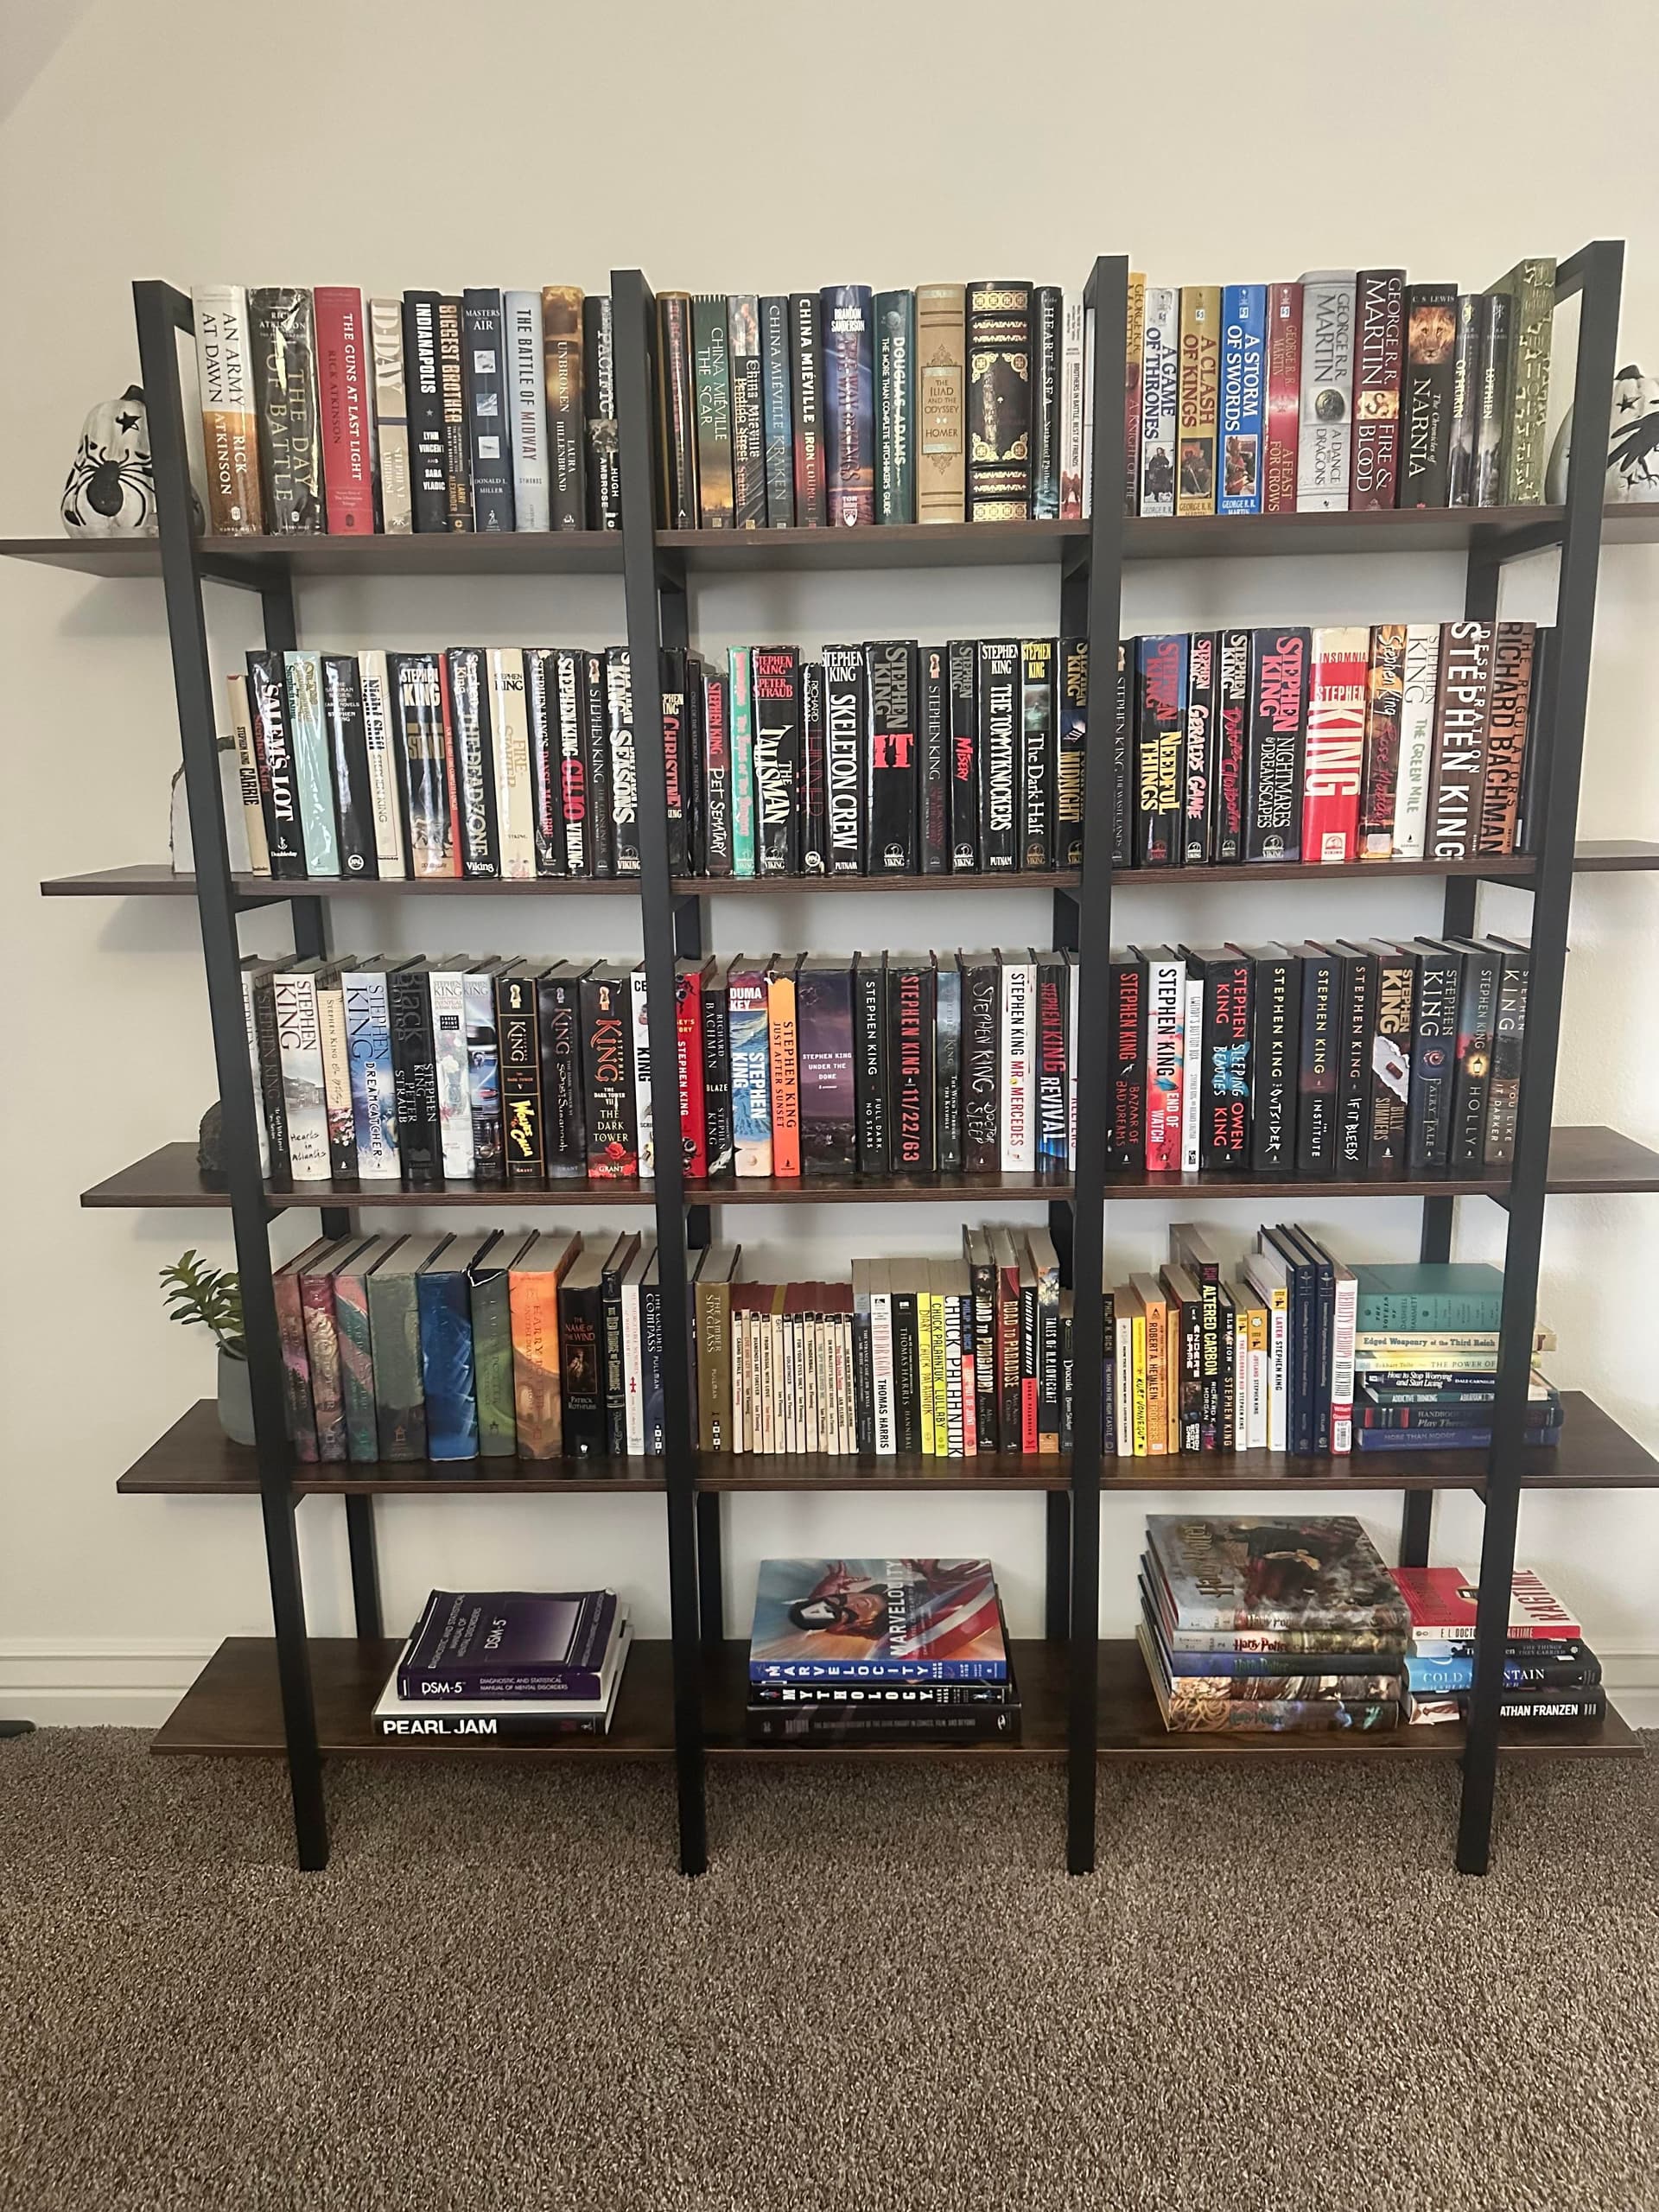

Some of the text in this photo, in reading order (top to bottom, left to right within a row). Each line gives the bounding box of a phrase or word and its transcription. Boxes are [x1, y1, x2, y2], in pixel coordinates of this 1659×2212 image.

[202, 313, 223, 403] AT DAWN
[416, 302, 435, 394] INDIANAPOLIS
[439, 304, 460, 359] BIGGEST
[474, 320, 494, 331] AIR
[1314, 294, 1336, 382] MARTIN
[1362, 278, 1387, 385] MARTIN
[1384, 277, 1402, 385] GEORGE R. R.
[223, 313, 245, 406] AN ARMY
[517, 309, 537, 461] THE BATTLE OF MIDWAY
[556, 341, 570, 413] UNBROKEN
[697, 347, 713, 427] THE SCAR
[711, 327, 728, 442] CHINA MIÉVILLE
[769, 304, 784, 429] CHINA MIÉVILLE
[799, 298, 817, 461] CHINA MIÉVILLE IRON
[1144, 327, 1161, 440] OF THRONES
[1160, 346, 1177, 417] A GAME
[1181, 334, 1198, 429] OF KINGS
[1199, 335, 1217, 426] A CLASH
[1224, 325, 1243, 432] OF SWORDS
[1243, 334, 1261, 417] A STORM
[343, 313, 362, 481] THE GUNS AT LAST LIGHT
[442, 364, 462, 423] BROTHER
[925, 405, 959, 414] ODYSSEY
[214, 413, 232, 495] ATKINSON
[233, 435, 247, 474] RICK
[270, 404, 293, 501] BATTLE
[289, 369, 314, 487] THE DAY
[556, 421, 566, 492] HILLENBRAND
[925, 429, 958, 438] HOMER
[1282, 449, 1294, 461] A
[1314, 429, 1327, 486] DRAGONS
[1356, 424, 1376, 492] BLOOD
[1378, 424, 1395, 463] FIRE
[1409, 378, 1433, 478] NARNIA
[600, 457, 609, 508] AMBROSE
[1268, 467, 1281, 512] CROWS
[830, 667, 856, 683] KING
[874, 663, 891, 716] KING
[885, 646, 907, 729] STEPHEN
[1259, 654, 1280, 717] KING
[1273, 636, 1303, 732] STEPHEN
[1319, 652, 1367, 664] INSOMNIA
[1316, 685, 1366, 702] STEPHEN
[610, 729, 635, 824] SEASONS
[663, 715, 682, 808] CHRISTINE
[830, 693, 858, 850] SKELETON CREW
[873, 733, 913, 768] IT
[990, 717, 1012, 831] TOMMYKNOCKERS
[1141, 739, 1159, 811] THINGS
[1158, 731, 1182, 816] NEEDFUL
[1273, 737, 1294, 828] NIGHTMARES
[1304, 708, 1365, 797] KING
[1409, 741, 1426, 782] GREEN
[239, 767, 259, 806] CARRIE
[1027, 733, 1045, 836] The Dark Half
[1258, 742, 1275, 829] DREAMSCAPES
[566, 822, 584, 868] VIKING
[1434, 785, 1470, 857] KING
[275, 982, 301, 1051] KING
[296, 981, 317, 1051] STEPHEN
[729, 987, 762, 1000] DUMA
[731, 1000, 750, 1010] KEY
[1156, 969, 1177, 1077] STEPHEN KING
[1217, 983, 1230, 1025] KING
[1232, 969, 1248, 1039] STEPHEN
[1379, 969, 1402, 1034] KING
[1398, 969, 1414, 1033] STEPHEN
[866, 981, 878, 1077] STEPHEN KING
[1009, 973, 1025, 1147] STEPHEN KING MERCEDES
[677, 1040, 689, 1116] STEPHEN KING
[733, 1052, 748, 1089] KING
[749, 1052, 767, 1119] STEPHEN
[774, 1051, 783, 1084] AFTER
[784, 1021, 797, 1128] STEPHEN KING
[900, 976, 919, 1162] STEPHEN KING 11/22/63
[1213, 1046, 1227, 1097] BEAUTIES
[1231, 1043, 1245, 1097] SLEEPING
[365, 1062, 383, 1157] DREAMCATCHER
[594, 1133, 628, 1142] TOWER
[598, 1122, 624, 1130] DARK
[600, 1109, 620, 1119] THE
[775, 1089, 785, 1128] SUNSET
[1039, 1077, 1066, 1144] REVIVAL
[1151, 1109, 1164, 1144] WATCH
[1166, 1092, 1179, 1128] END OF
[1214, 1107, 1228, 1147] KING
[1230, 1103, 1244, 1151] OWEN
[1312, 1099, 1323, 1158] INSTITUTE
[1373, 1097, 1389, 1141] SUMMERS
[1389, 1106, 1405, 1131] BILLY
[1465, 1086, 1481, 1146] HOLLY
[645, 1293, 657, 1353] COMPASS
[706, 1294, 715, 1353] SPYGLASS
[1003, 1300, 1019, 1389] ROAD PARADISE
[1202, 1285, 1217, 1376] ALTERED CARBON
[1274, 1317, 1283, 1372] LATER STEPHEN
[1363, 1338, 1387, 1346] Edged
[1389, 1338, 1427, 1347] Weaponry
[931, 1302, 946, 1429] CHUCK PALAHNIUK LULLABY
[877, 1379, 889, 1449] THOMAS HARRIS
[485, 1618, 507, 1649] DSM-5
[886, 1560, 905, 1656] MARVELOCITY
[766, 1665, 929, 1677] MARVELOCITY
[1234, 1637, 1289, 1652] Harry Potter
[1423, 1673, 1463, 1683] COLD
[422, 1681, 463, 1694] DSM-5
[1533, 1704, 1578, 1716] FRANZEN
[383, 1719, 497, 1735] PEARL JAM
